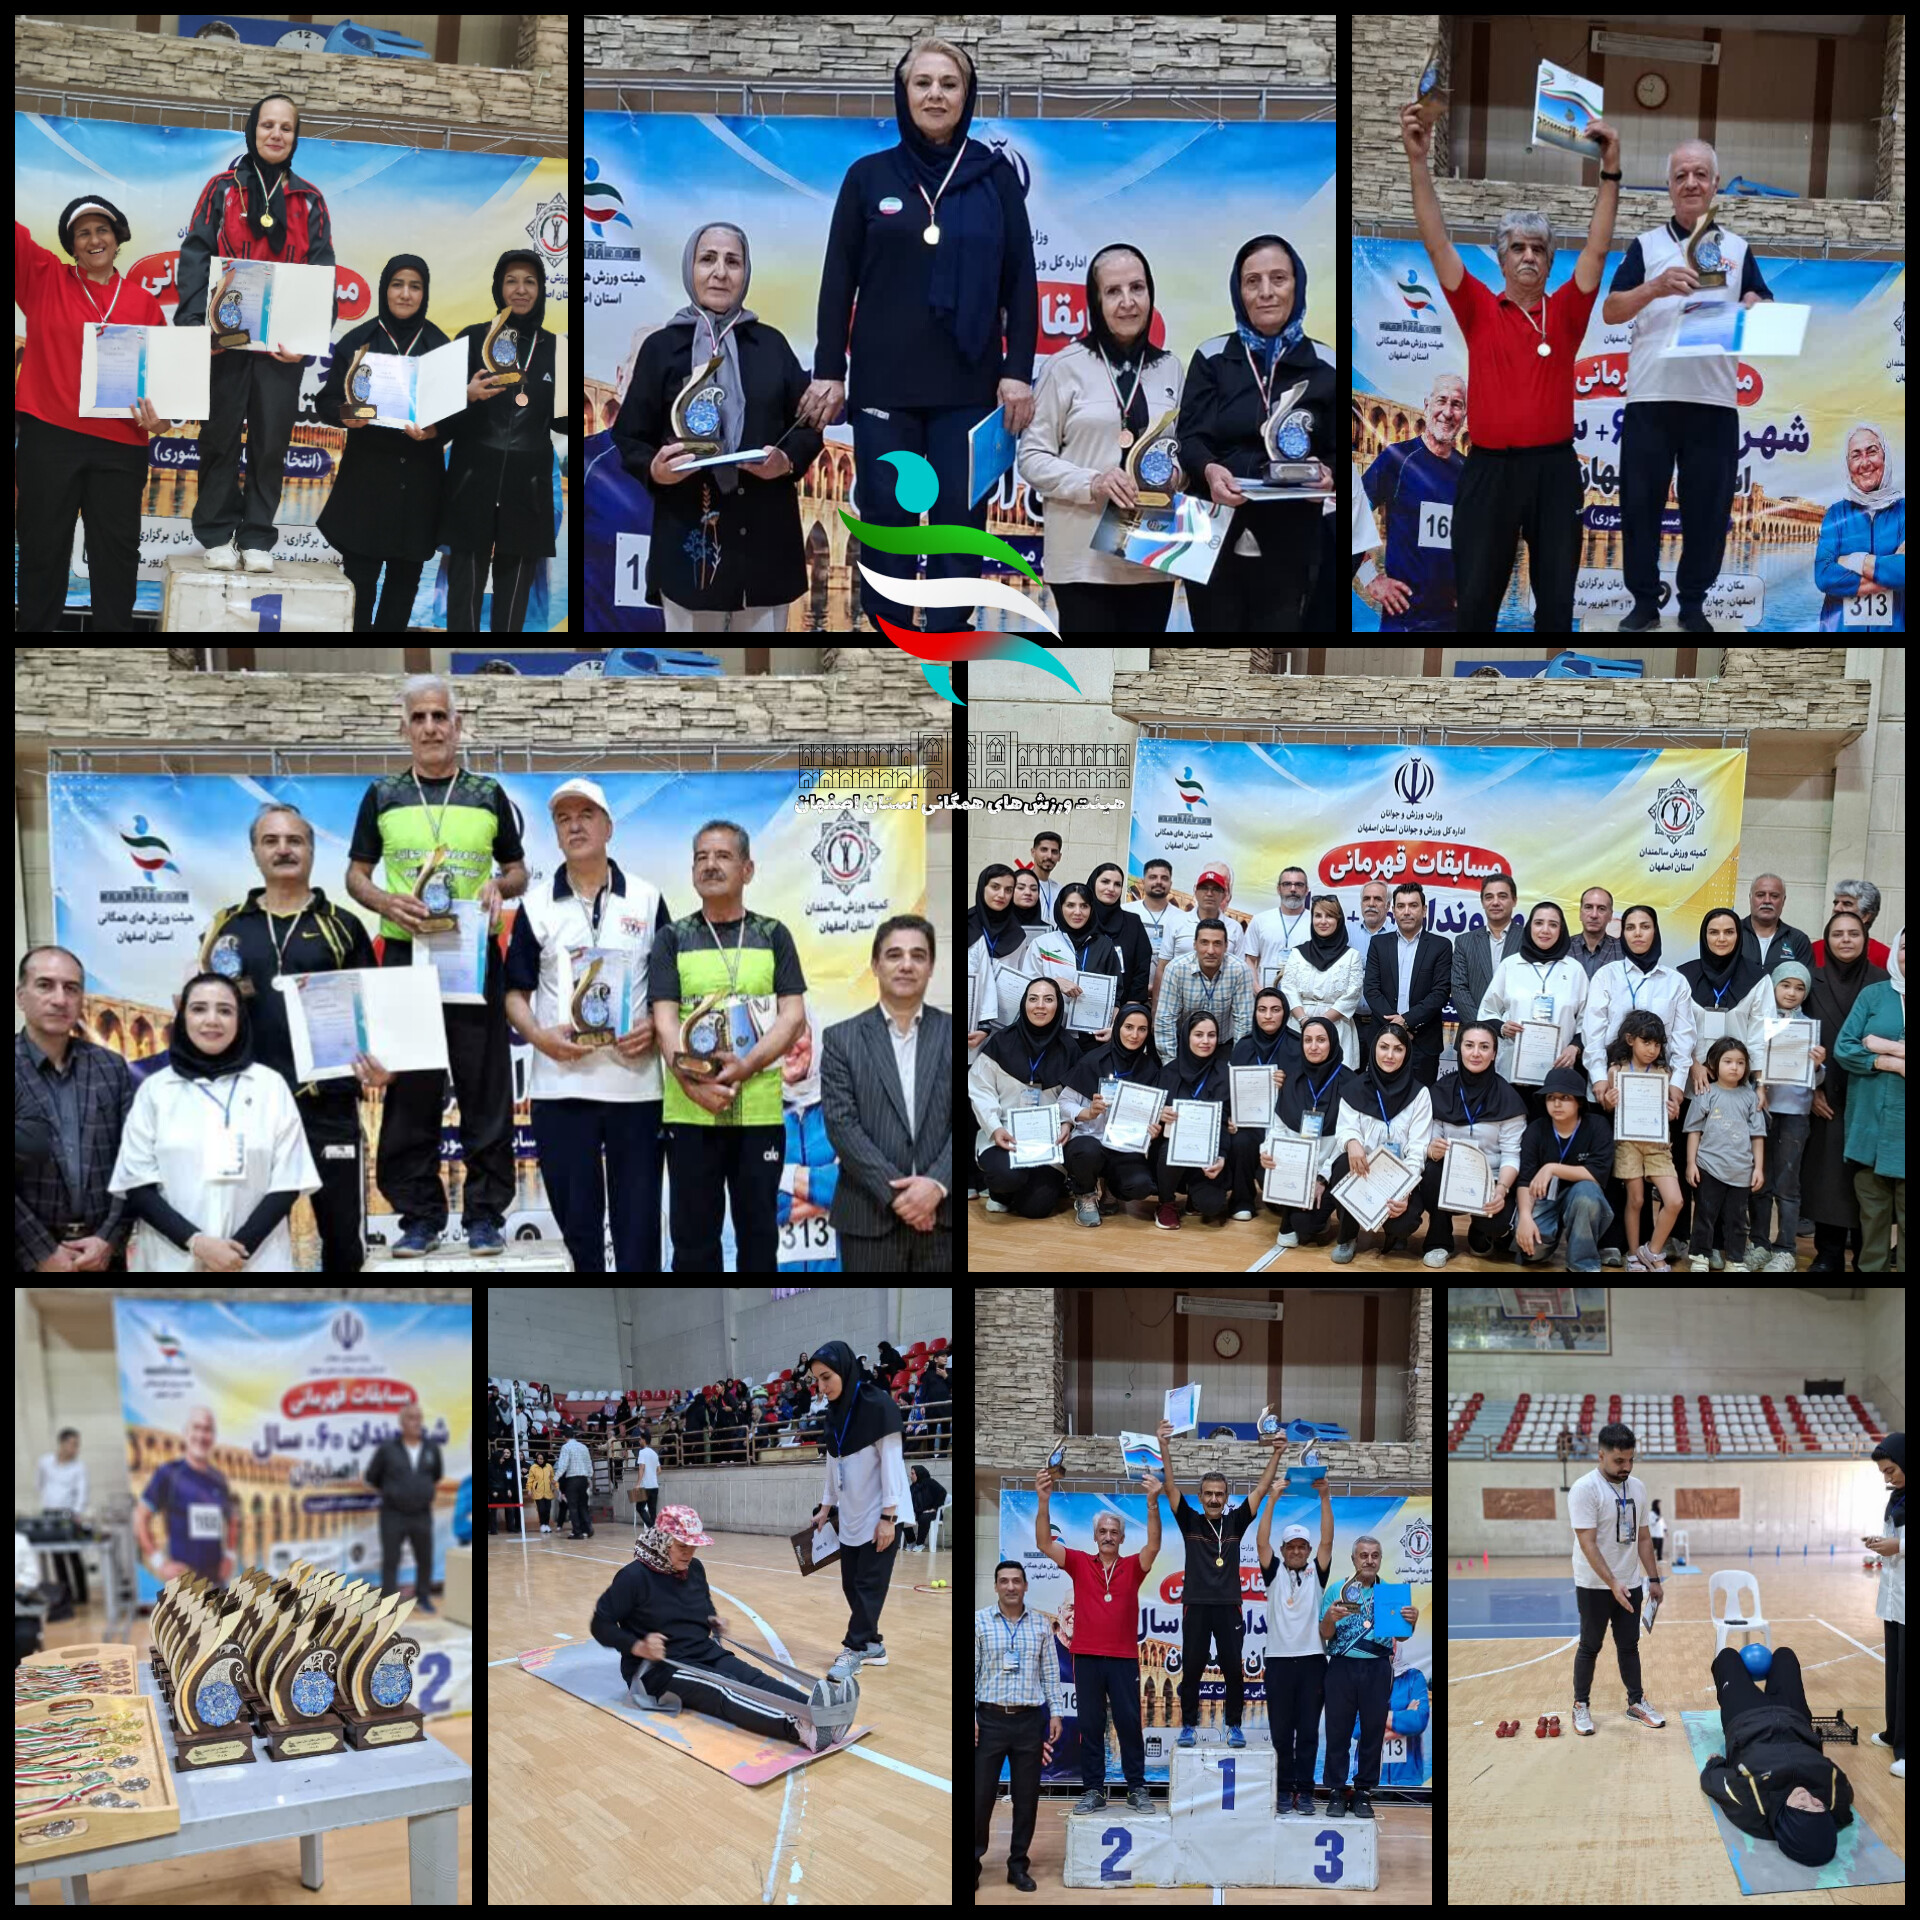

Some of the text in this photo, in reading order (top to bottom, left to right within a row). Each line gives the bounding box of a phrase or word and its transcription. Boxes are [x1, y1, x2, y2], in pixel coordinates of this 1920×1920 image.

[297, 30, 311, 39] 12
[1050, 254, 1065, 271] کل
[1066, 256, 1087, 271] اداره
[592, 270, 619, 286] ورزش
[620, 271, 646, 286] هیئت
[594, 292, 622, 307] استان
[1376, 337, 1444, 350] هیئت ورزش های همگانی
[1388, 351, 1429, 362] استان اصفهان
[1575, 360, 1628, 394] رمانی
[154, 440, 201, 465] شوری)
[284, 451, 322, 472] (انتخا
[1426, 513, 1449, 539] 16
[139, 527, 193, 545] زمان برگزاری
[284, 532, 320, 549] برگزاری:
[1607, 579, 1624, 590] زمان
[1727, 580, 1745, 592] مکان
[1588, 599, 1609, 609] شهریور
[1850, 592, 1888, 617] 313
[585, 661, 602, 671] 12
[1380, 809, 1400, 819] جوانان
[1406, 810, 1424, 820] ورزش
[1425, 811, 1443, 821] وزارت
[1155, 828, 1213, 840] هیئت ورزش های همگانی
[1358, 823, 1379, 833] اصفهان
[1379, 824, 1398, 834] استان
[1399, 825, 1418, 835] جوانان
[1424, 825, 1442, 836] ورزش
[1165, 841, 1199, 851] استان اصفهان
[1639, 847, 1707, 859] کمیته ورزش سالمندان
[1329, 844, 1502, 883] مسابقات قهرمانی
[1649, 862, 1694, 873] استان اصفهان
[805, 898, 889, 915] کمیته ورزش سالمندان
[98, 911, 194, 926] هیئت ورزش های همگانی
[819, 920, 874, 934] استان اصفهان
[117, 931, 174, 944] استان اصفهان
[781, 1217, 829, 1250] 313
[289, 1383, 413, 1413] مسابقات قهرمانی
[253, 1423, 300, 1458] سال
[418, 1651, 451, 1715] 2
[1062, 1691, 1078, 1710] 16
[1385, 1738, 1403, 1757] 13
[1218, 1757, 1236, 1810] 1
[1101, 1827, 1132, 1881] 2
[1314, 1830, 1345, 1883] 3
